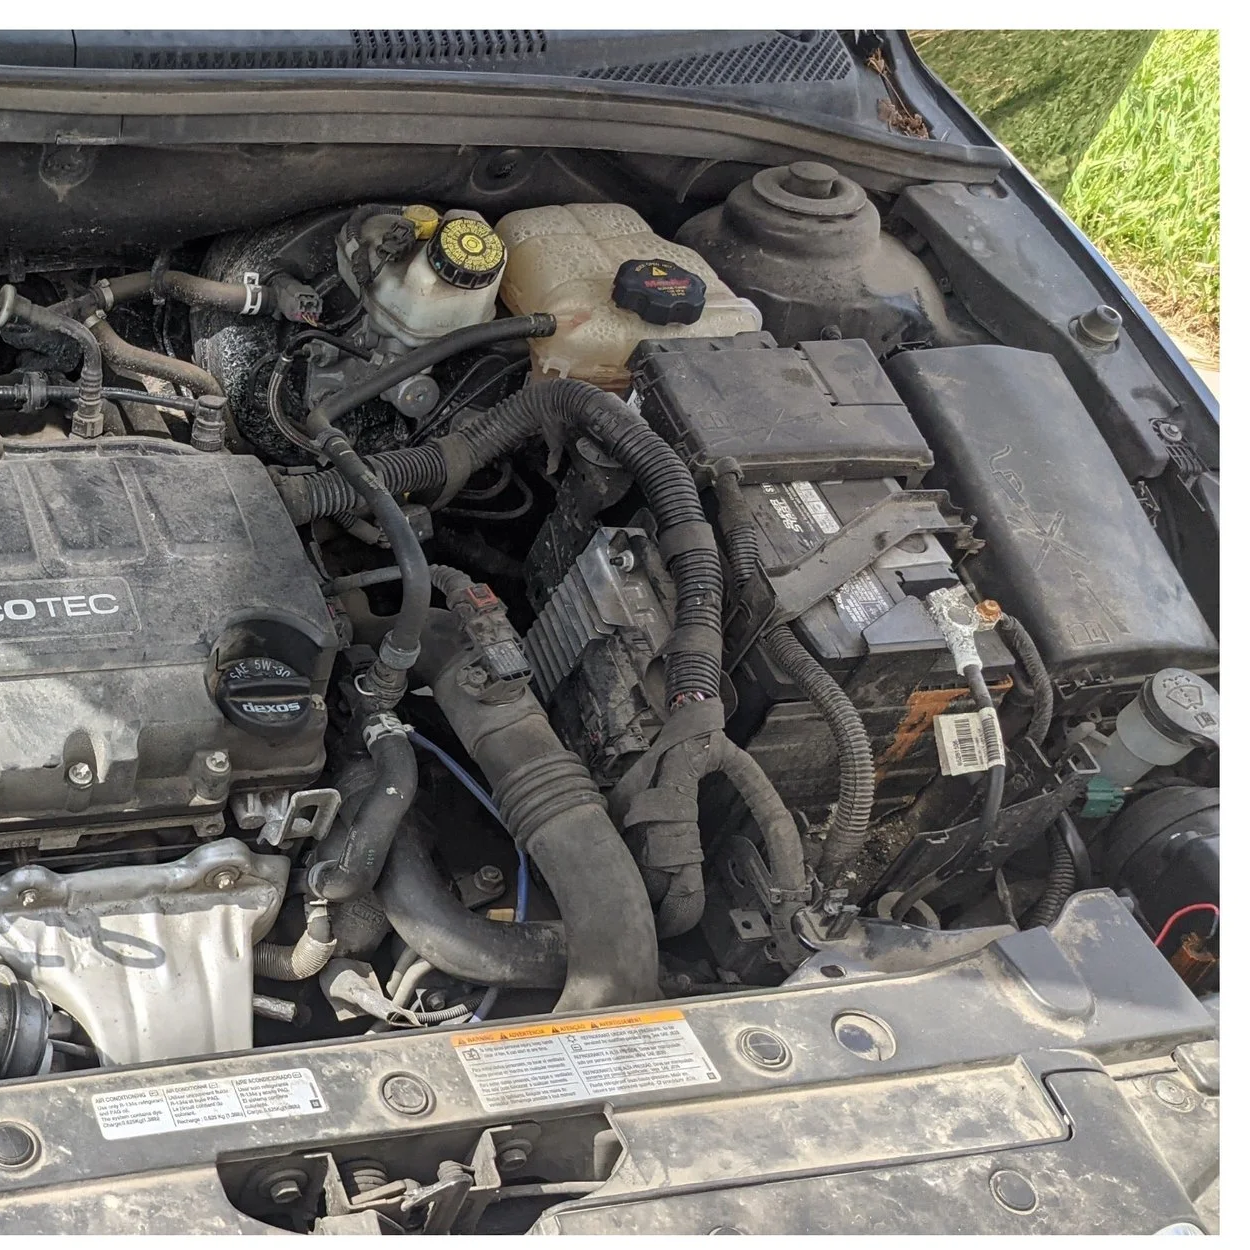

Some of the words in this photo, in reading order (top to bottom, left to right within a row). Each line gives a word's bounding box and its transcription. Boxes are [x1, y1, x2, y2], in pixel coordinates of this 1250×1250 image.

[769, 499, 792, 529] SUPER
[780, 497, 804, 533] START
[230, 662, 249, 679] SAE
[254, 659, 291, 678] 5W-30
[242, 702, 301, 713] dexos
[106, 1093, 146, 1103] CONDITIONING
